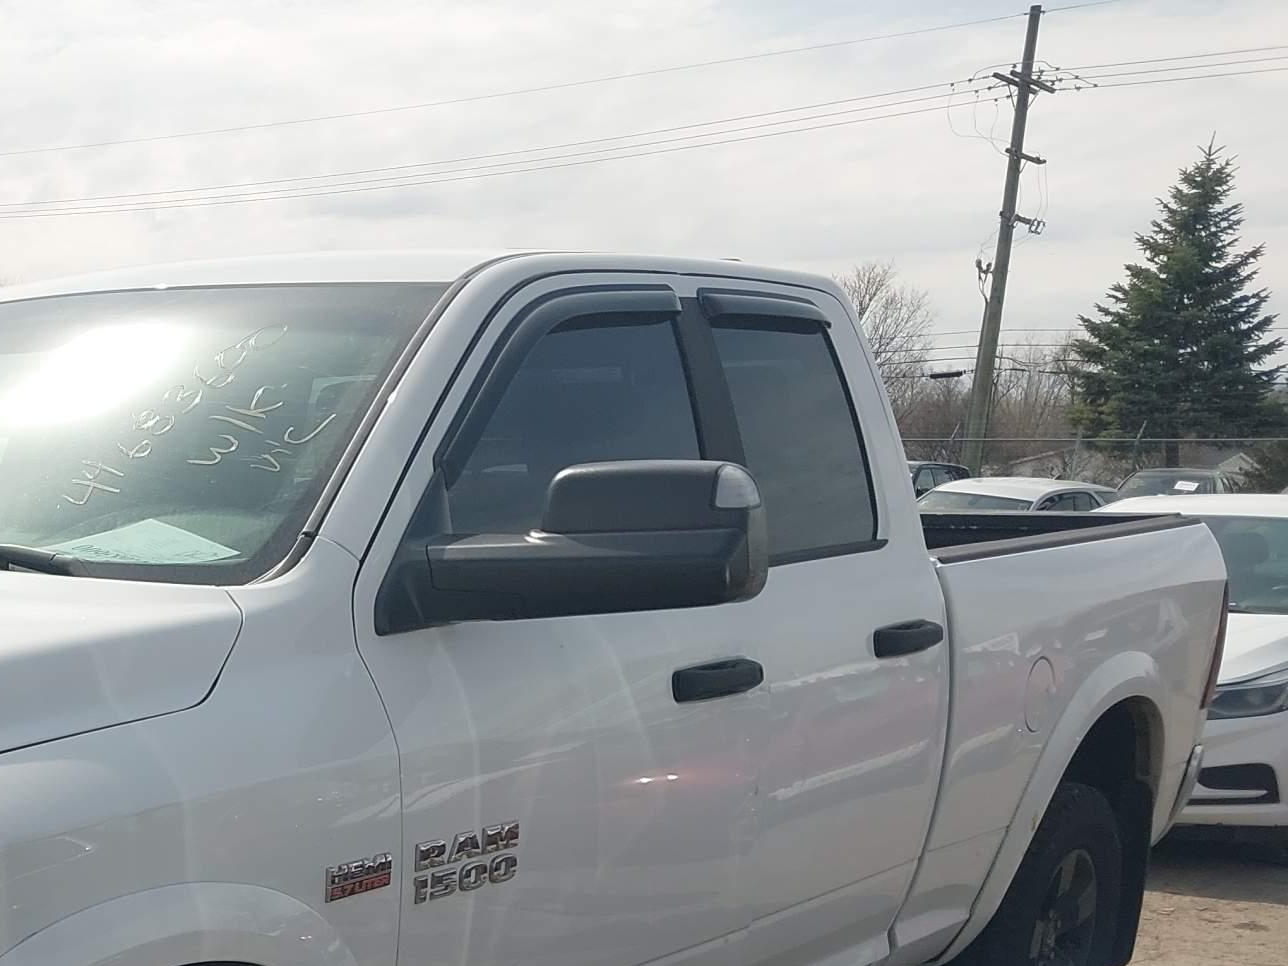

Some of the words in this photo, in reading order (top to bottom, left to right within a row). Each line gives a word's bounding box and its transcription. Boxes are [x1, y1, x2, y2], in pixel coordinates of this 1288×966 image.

[327, 852, 392, 886] HEMI
[415, 820, 519, 872] RAM
[414, 853, 518, 904] 1500
